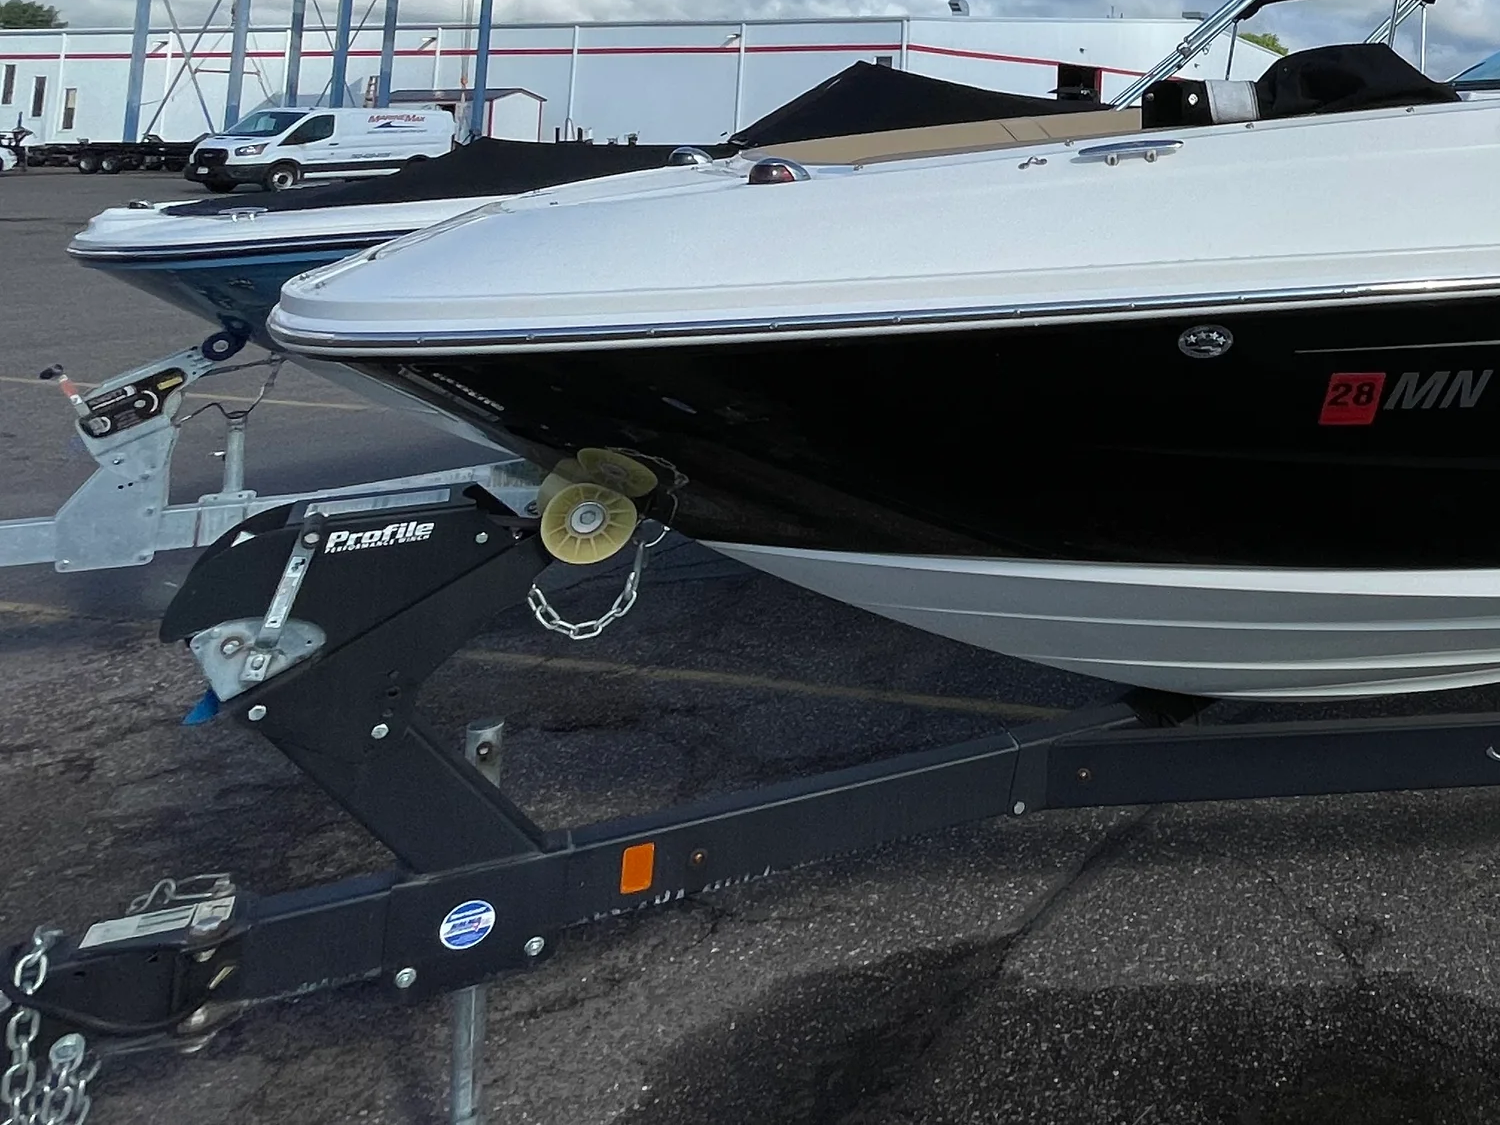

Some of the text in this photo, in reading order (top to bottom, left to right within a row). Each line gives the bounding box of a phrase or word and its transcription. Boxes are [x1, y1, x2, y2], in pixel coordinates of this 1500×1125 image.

[1327, 381, 1376, 407] 28
[1383, 369, 1494, 410] MN
[325, 521, 435, 549] Profile
